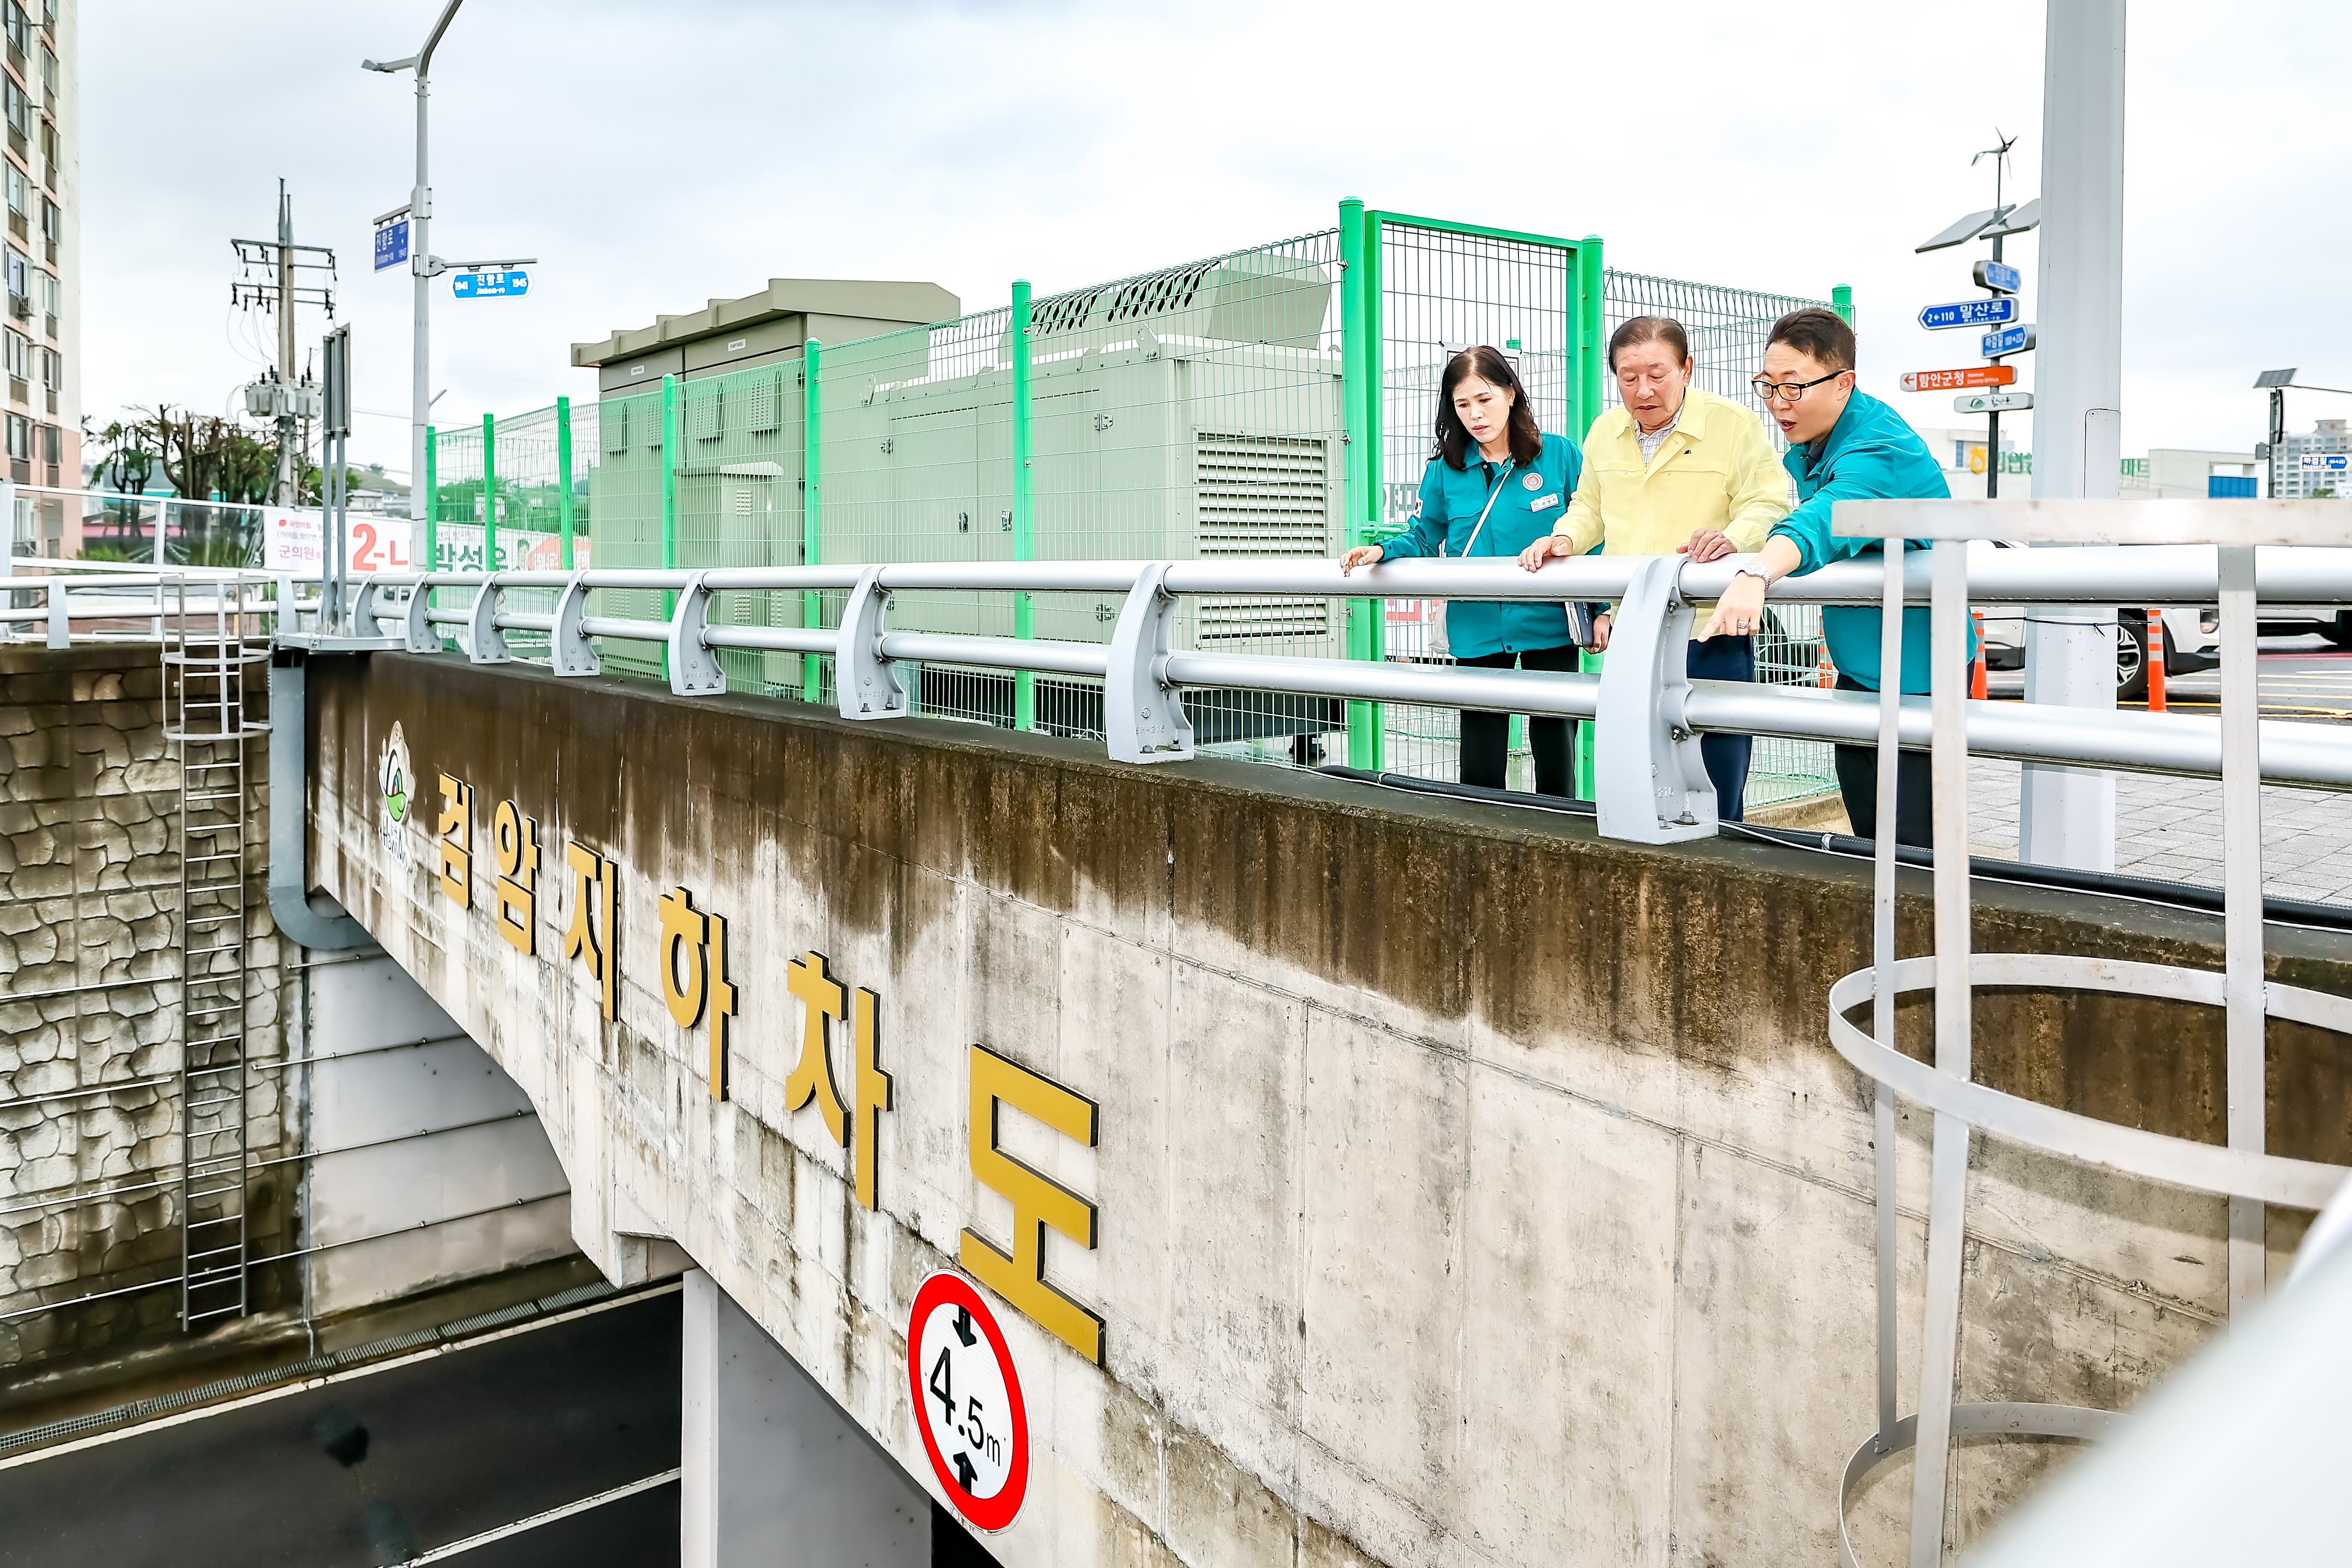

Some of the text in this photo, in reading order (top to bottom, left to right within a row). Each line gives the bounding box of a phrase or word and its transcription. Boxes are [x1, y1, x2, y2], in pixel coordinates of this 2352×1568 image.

[454, 281, 469, 290] 1941
[476, 273, 505, 286] 진함로
[512, 278, 527, 287] 1945
[1959, 302, 2005, 319] 말산로
[1918, 371, 1964, 388] 함안군청
[279, 545, 314, 560] 군의원
